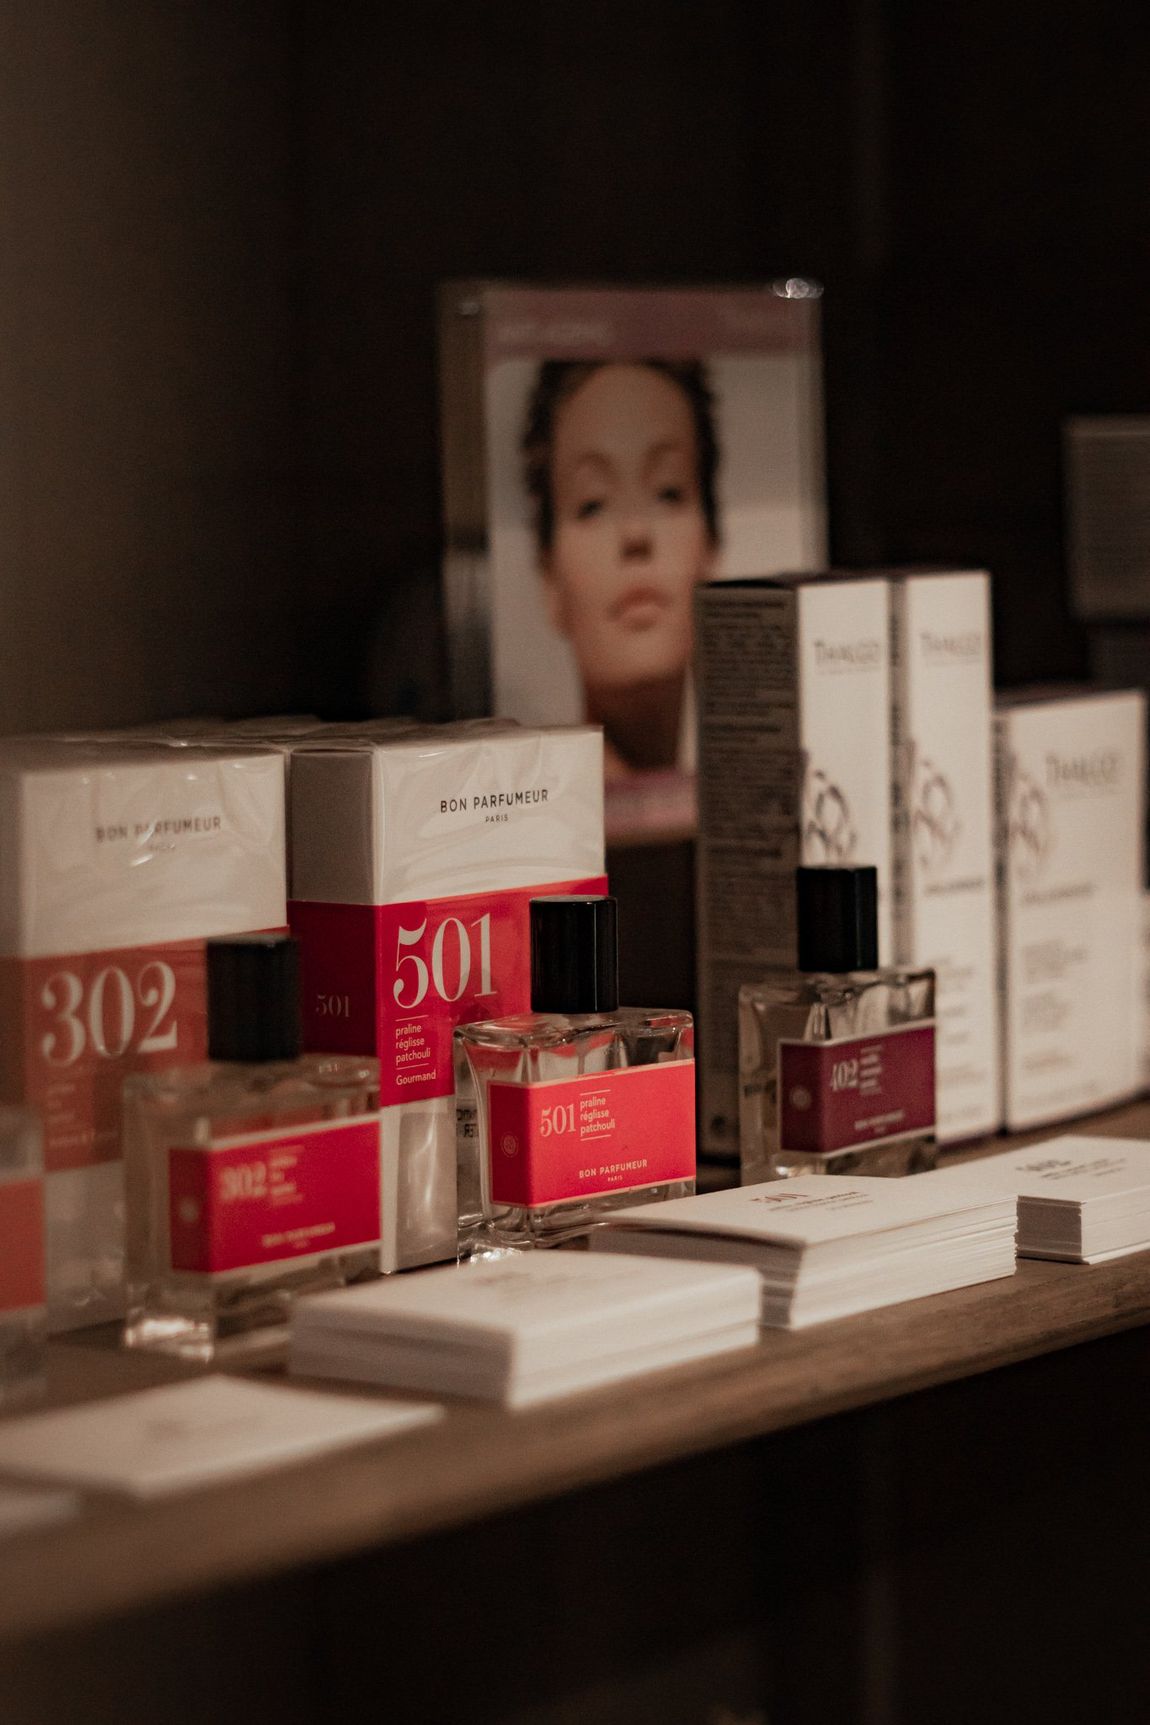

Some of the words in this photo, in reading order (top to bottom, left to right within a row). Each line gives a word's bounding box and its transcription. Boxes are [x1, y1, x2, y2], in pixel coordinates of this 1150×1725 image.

[440, 798, 467, 813] BON
[473, 789, 548, 810] PARFUMEUR
[485, 813, 509, 823] PARIS
[393, 912, 498, 1009] 501
[41, 960, 178, 1068] 302
[315, 994, 350, 1018] 501
[395, 1024, 423, 1040] praline
[395, 1036, 425, 1052] réglisse
[395, 1048, 431, 1066] patchouli
[396, 1069, 437, 1086] Gourmand
[580, 1096, 606, 1111] praline
[540, 1103, 576, 1137] 501
[580, 1108, 610, 1123] réglisse
[580, 1120, 616, 1137] patchouli
[579, 1168, 597, 1179] BON
[600, 1159, 648, 1176] PARFUMEUR
